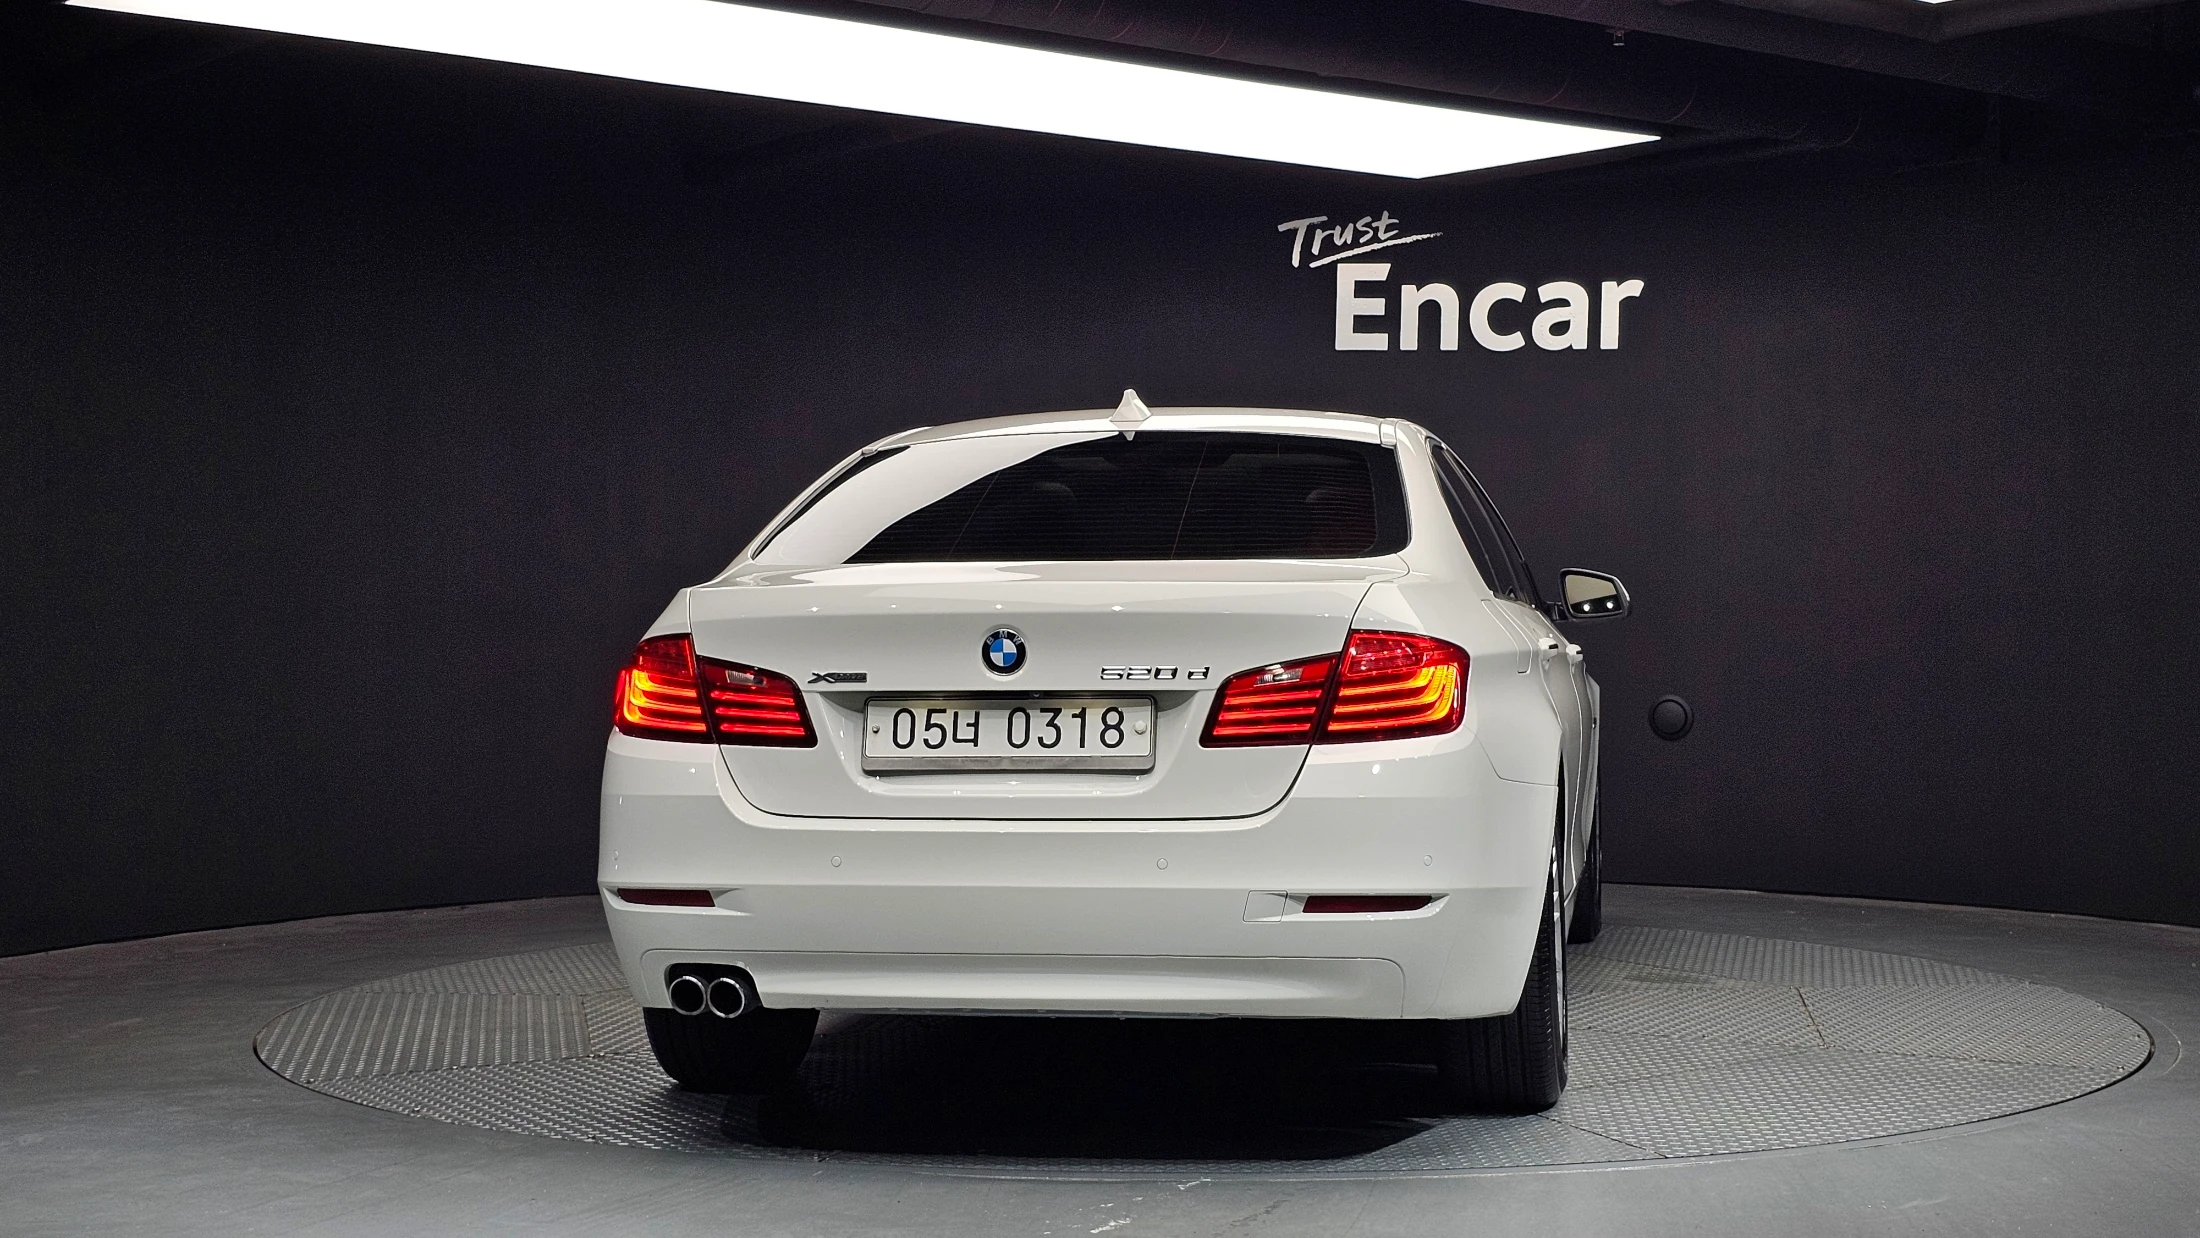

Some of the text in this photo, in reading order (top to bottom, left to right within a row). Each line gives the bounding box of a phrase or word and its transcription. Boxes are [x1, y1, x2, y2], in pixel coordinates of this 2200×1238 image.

[1278, 210, 1400, 268] Trust
[1335, 263, 1645, 352] Encar
[986, 630, 1022, 645] BMW
[892, 706, 1125, 750] 05너 0318
